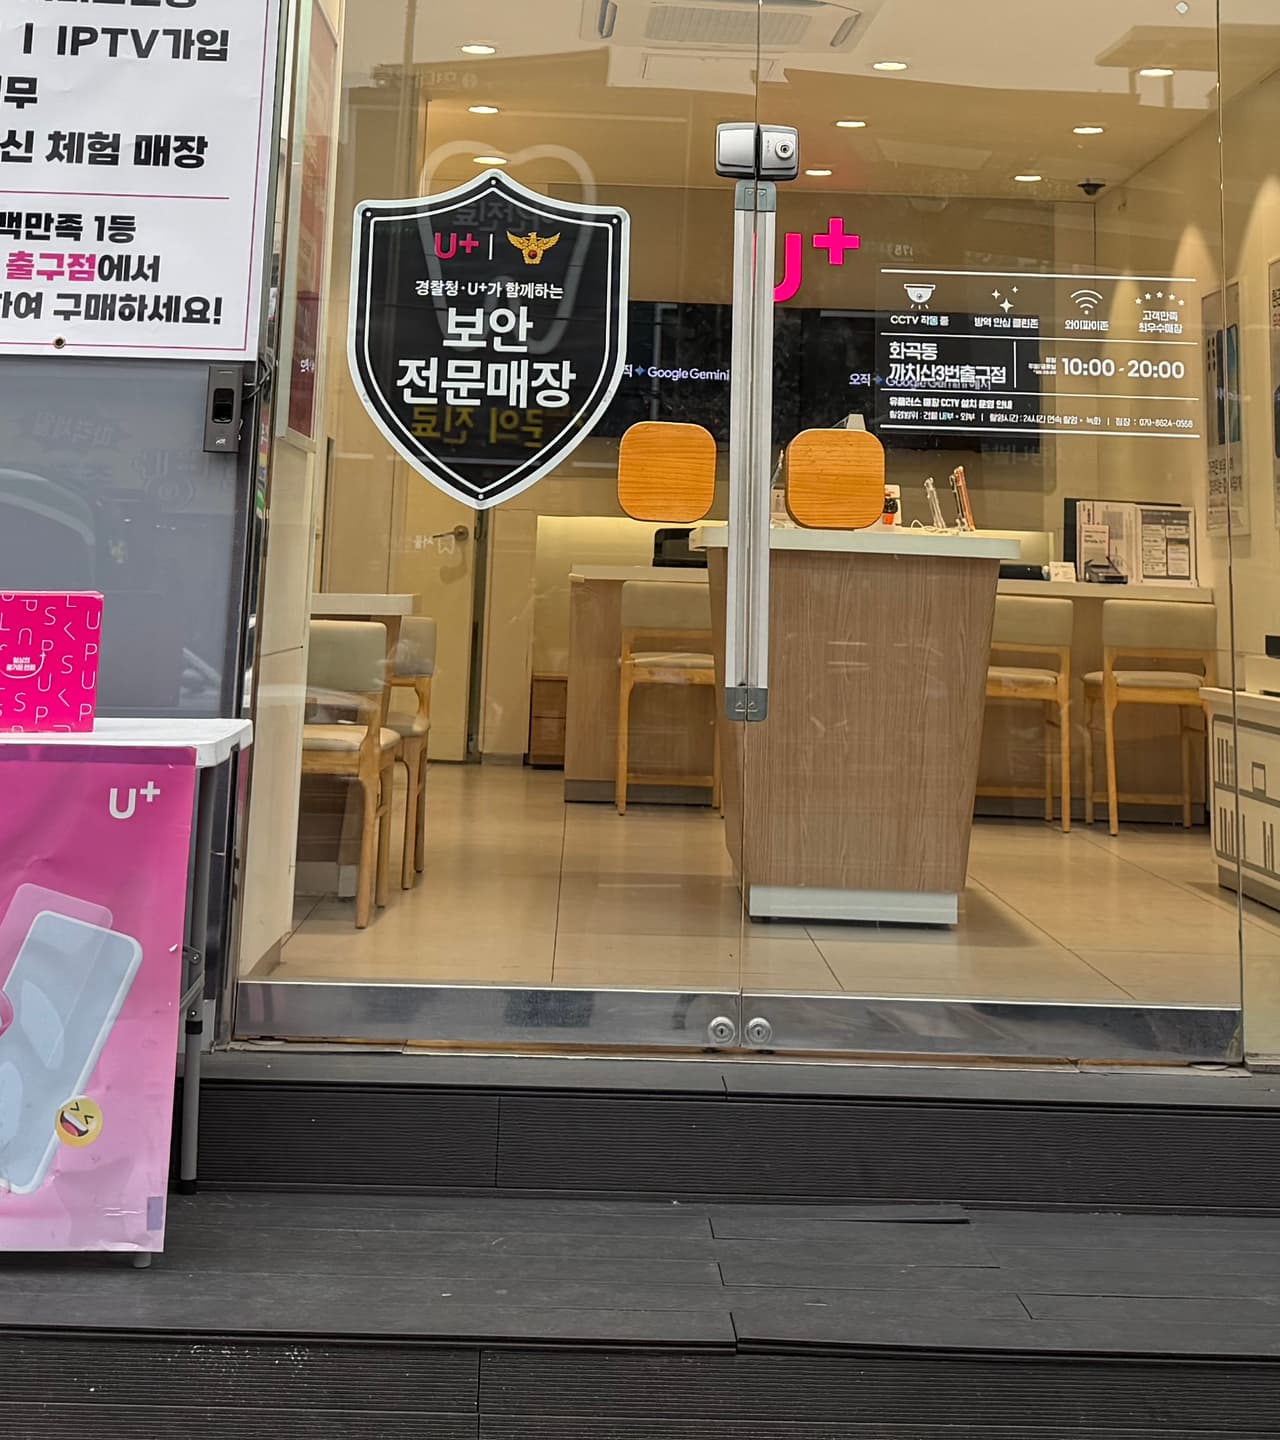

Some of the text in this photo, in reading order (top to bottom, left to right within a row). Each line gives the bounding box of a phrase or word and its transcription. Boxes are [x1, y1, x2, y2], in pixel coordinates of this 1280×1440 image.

[57, 22, 231, 62] IPTV가입
[46, 130, 122, 168] 체험
[133, 133, 209, 170] 매장
[93, 215, 137, 245] 1등
[433, 232, 480, 259] U+
[5, 250, 161, 284] 출구점에서
[505, 281, 564, 301] 함께하는
[52, 293, 224, 326] 구매하세요!
[890, 316, 919, 326] CCTV
[442, 306, 534, 353] 보안
[888, 341, 938, 361] 화곡동
[395, 358, 577, 409] 전문매장
[647, 366, 689, 383] Google
[1061, 357, 1116, 377] 10:00
[1127, 360, 1186, 379] 20:00
[108, 780, 161, 821] U+
